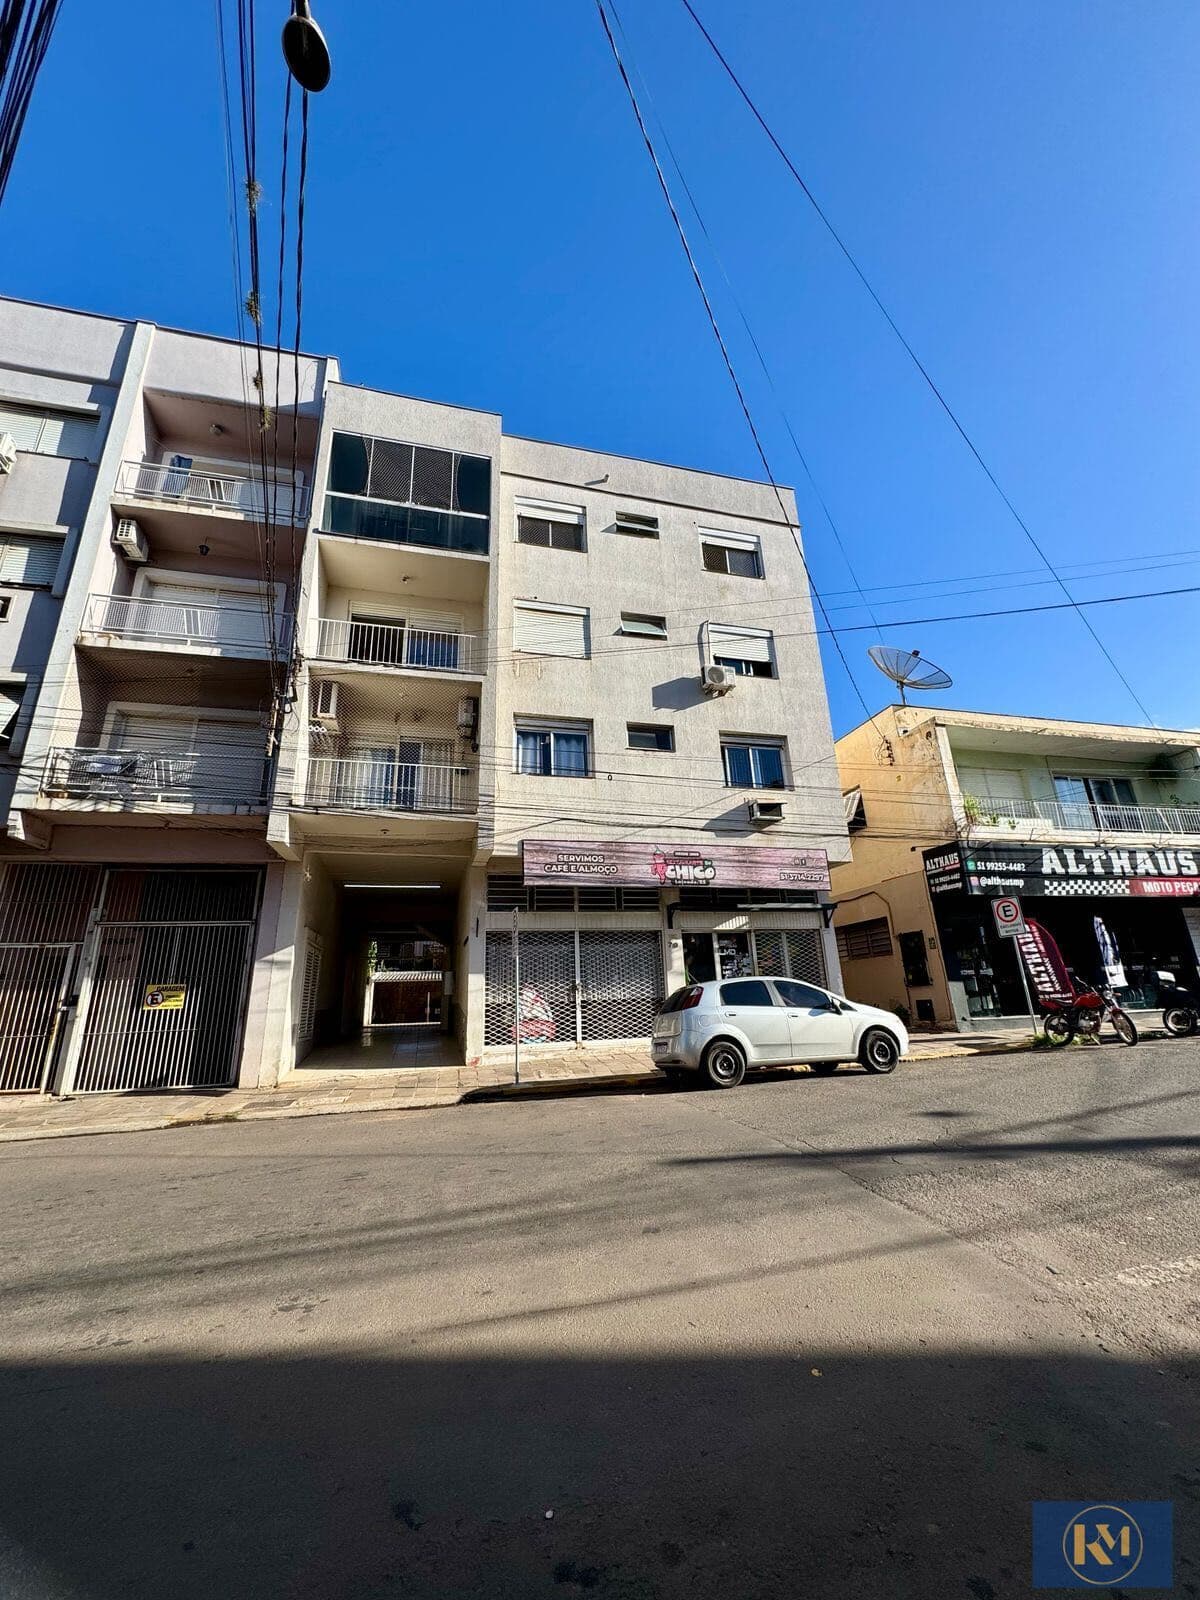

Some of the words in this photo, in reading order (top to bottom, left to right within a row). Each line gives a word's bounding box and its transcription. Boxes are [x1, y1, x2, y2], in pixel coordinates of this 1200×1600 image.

[557, 854, 604, 863] SERVIMOS
[926, 852, 960, 870] ALTHAUS
[1041, 848, 1199, 876] ALTHAUS
[544, 863, 569, 872] CAFÉ
[570, 864, 577, 872] E
[578, 865, 618, 875] ALMOÇO
[976, 861, 985, 870] 51
[665, 865, 716, 880] CHICO
[1142, 881, 1173, 893] MOTO
[1174, 881, 1200, 895] PEÇA
[1002, 905, 1014, 918] E
